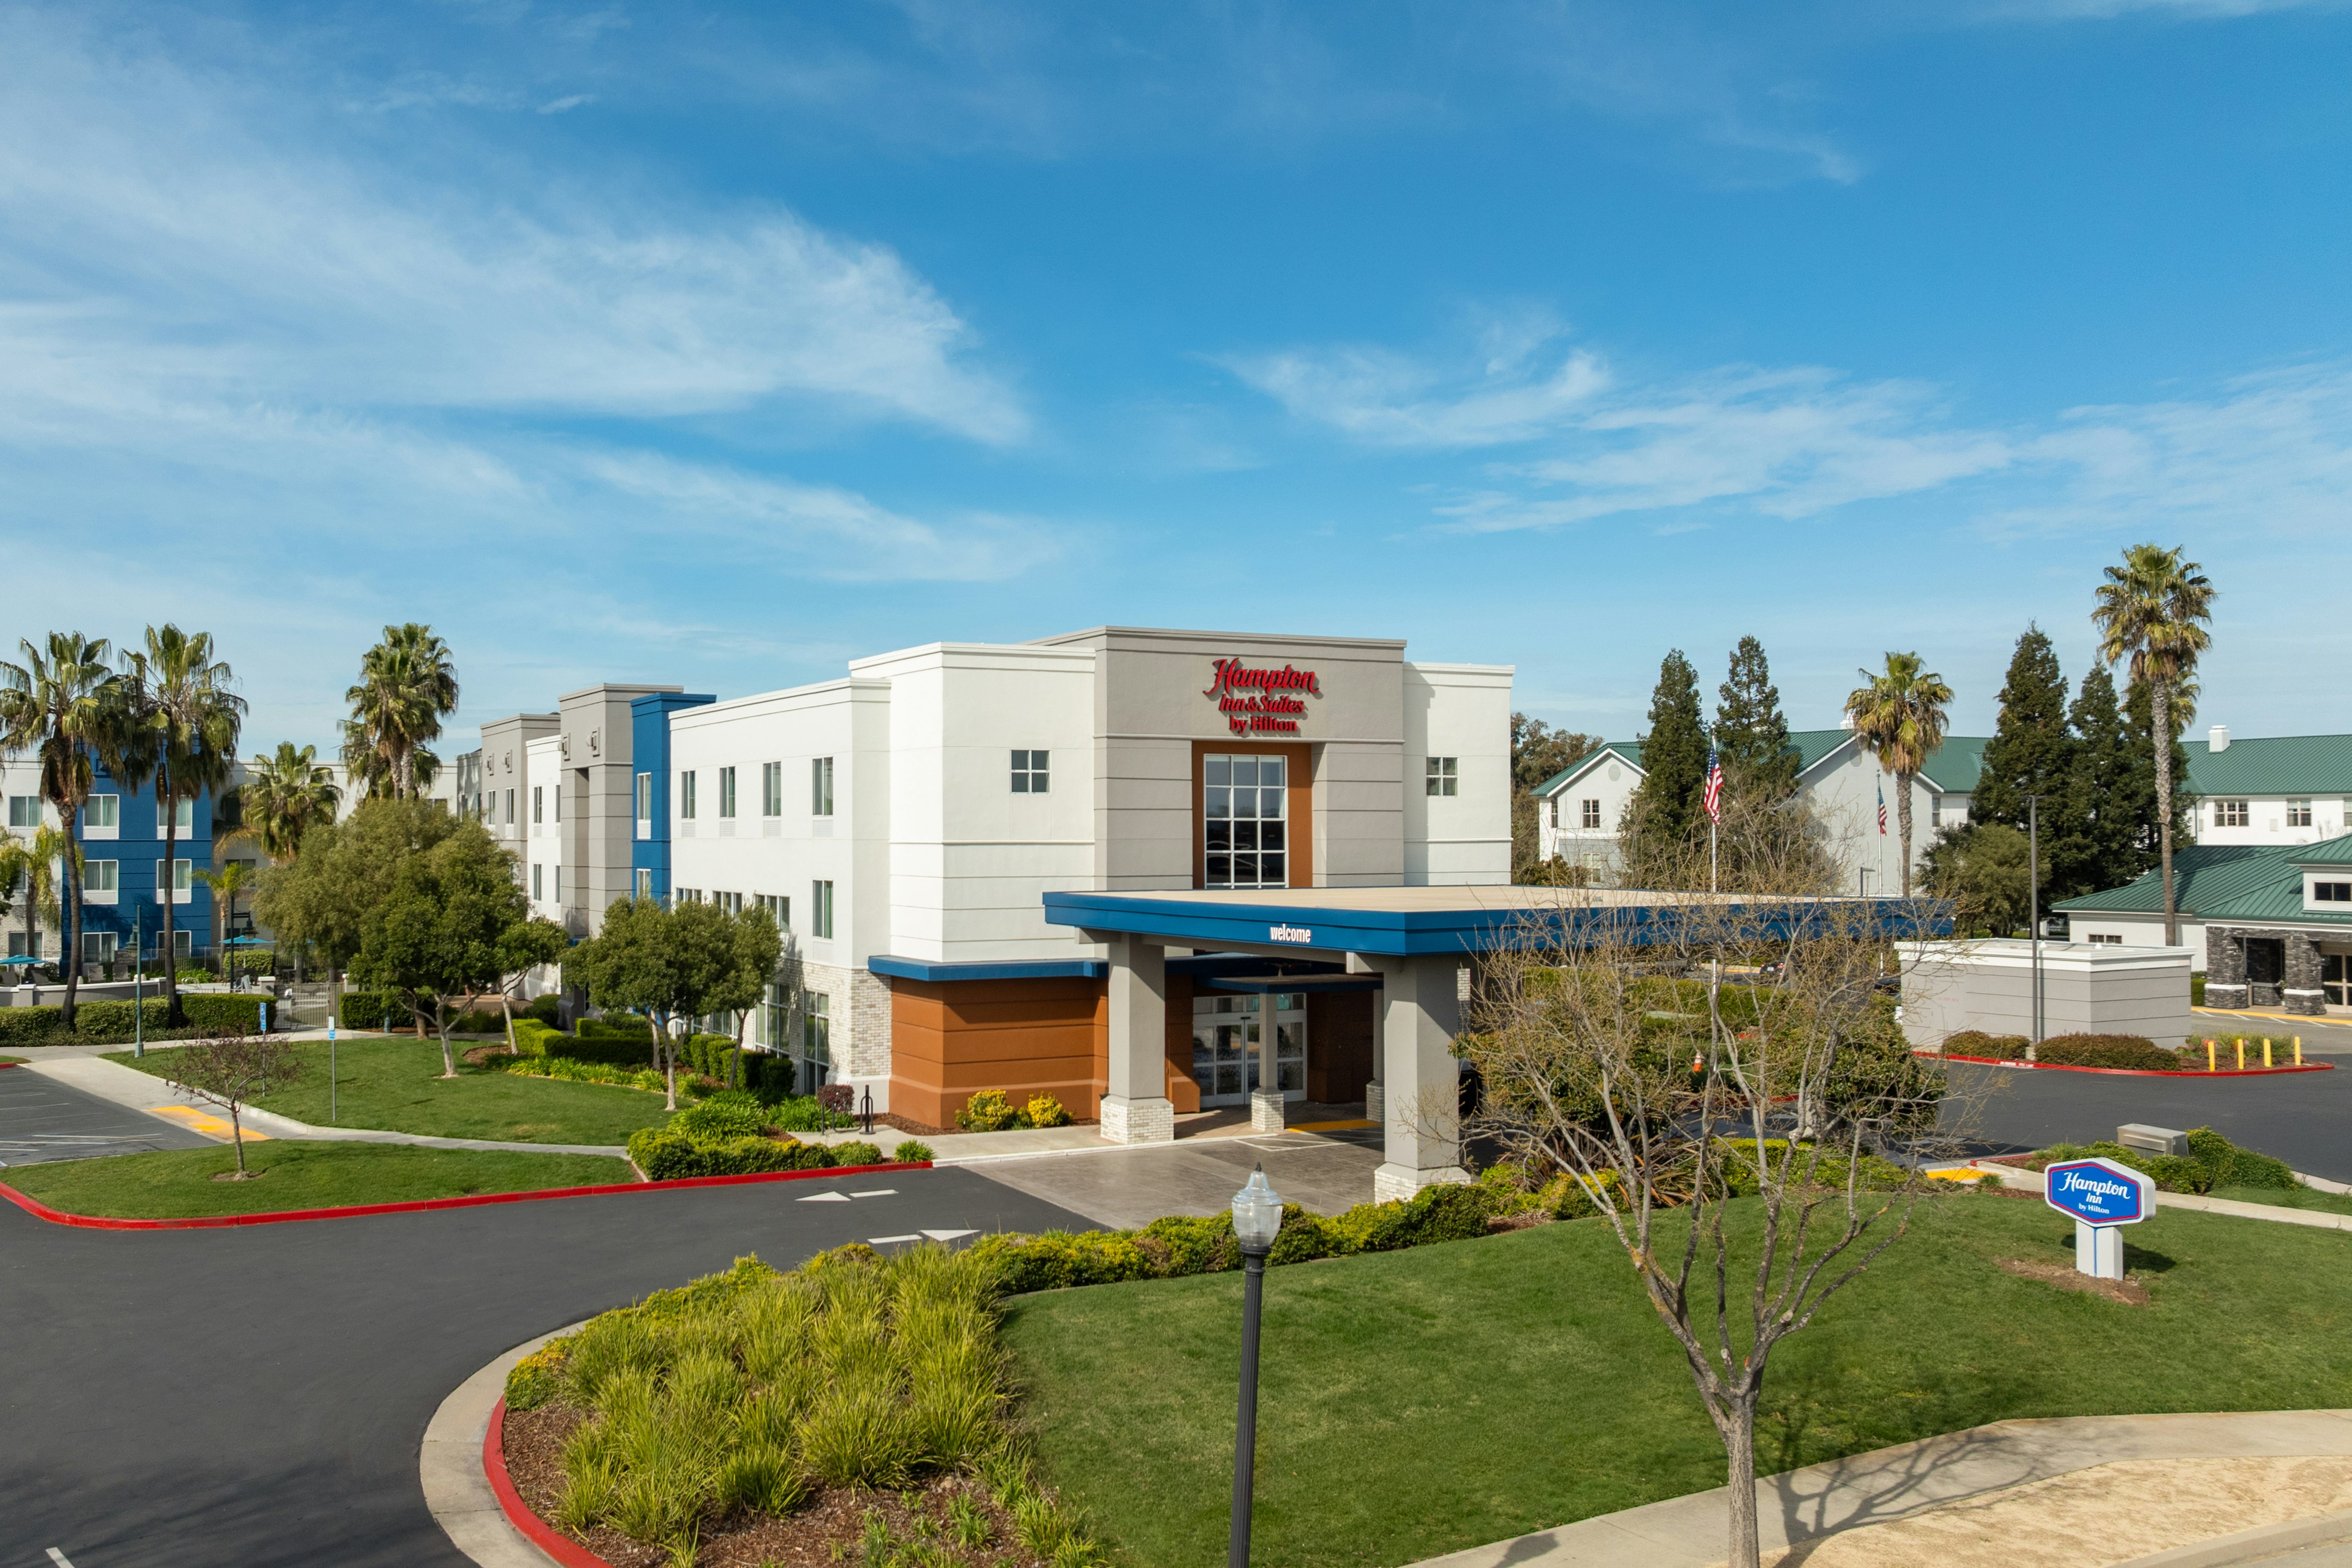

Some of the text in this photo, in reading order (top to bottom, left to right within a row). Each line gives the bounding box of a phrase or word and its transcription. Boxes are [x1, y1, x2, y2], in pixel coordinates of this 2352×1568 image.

[1203, 658, 1320, 694] Hampton
[1219, 694, 1304, 713] Inn & Suites
[1230, 715, 1297, 734] by Hilton
[1270, 923, 1311, 943] welcome
[2058, 1172, 2131, 1200] Hampton
[2085, 1192, 2103, 1204] Inn
[2078, 1203, 2110, 1214] by Hilton
